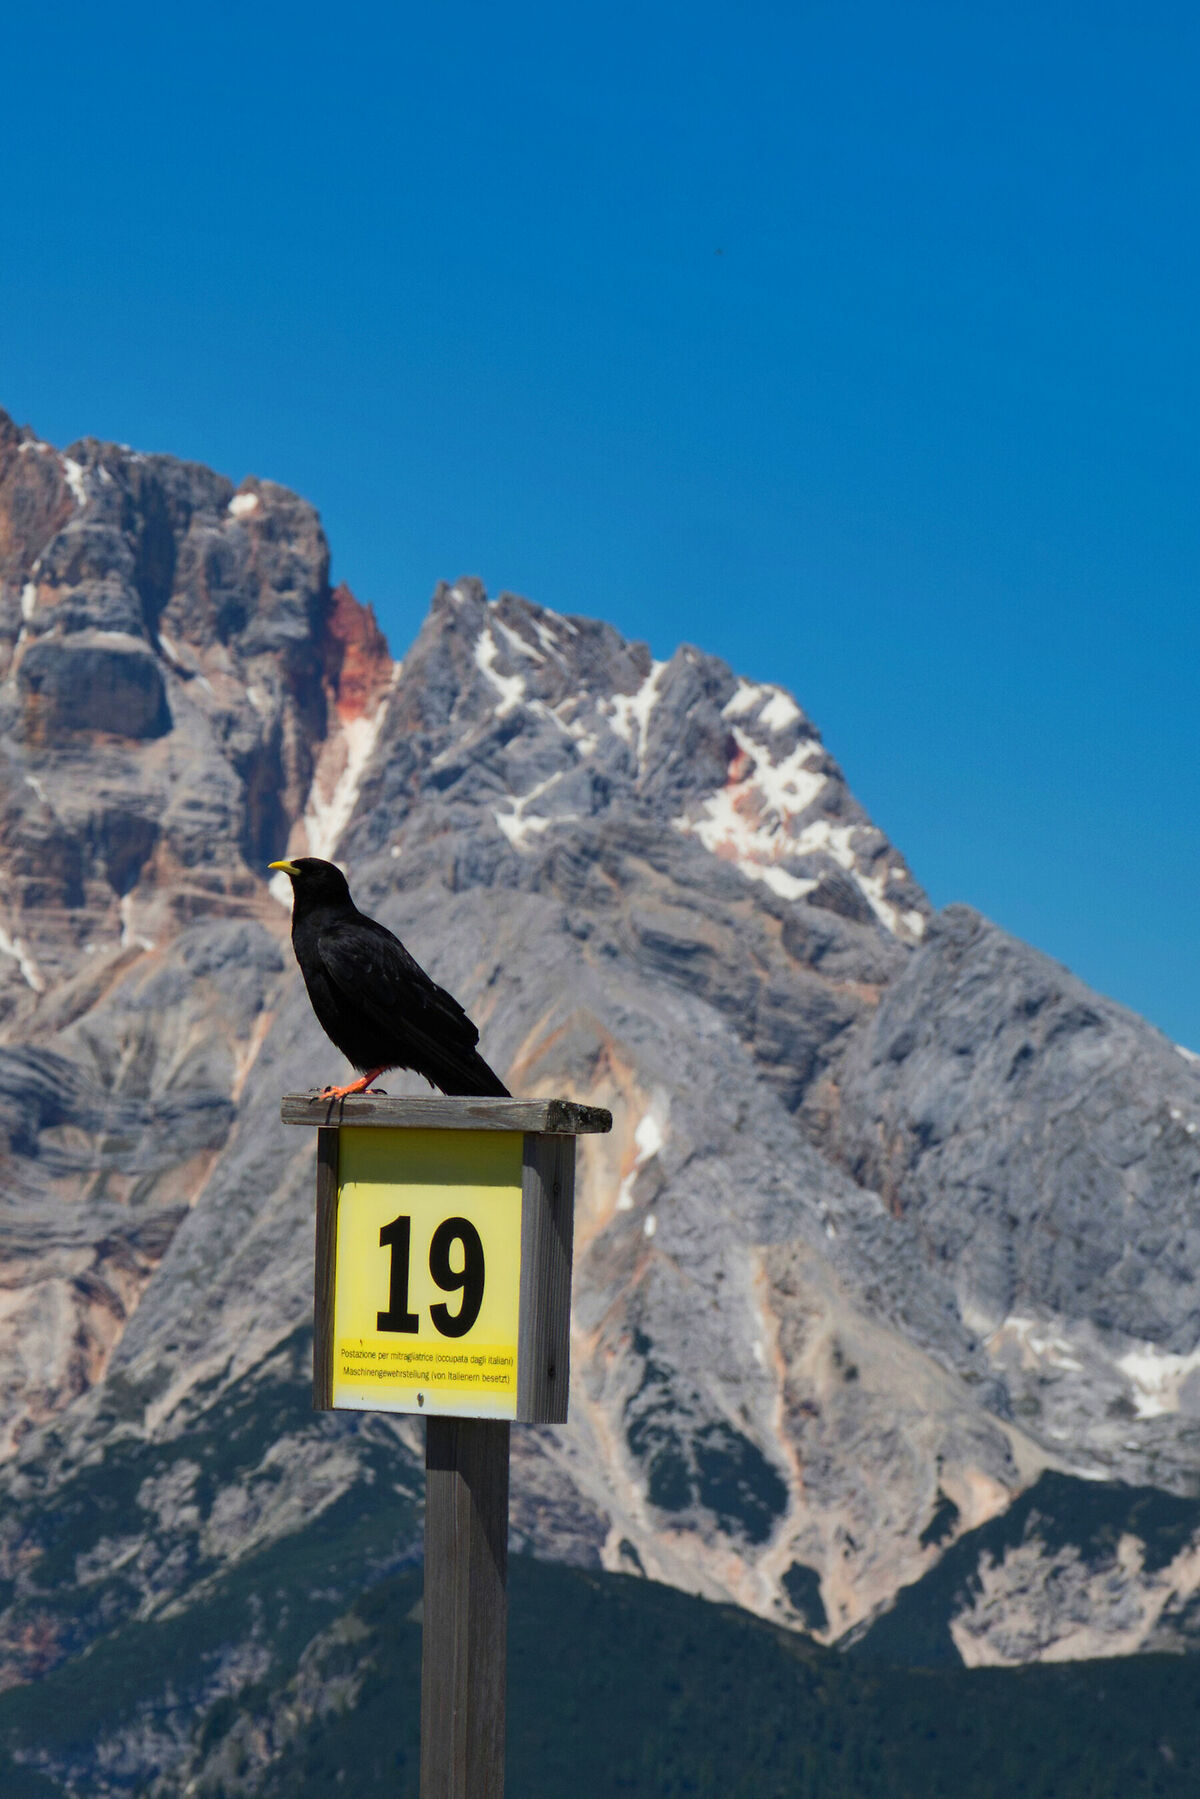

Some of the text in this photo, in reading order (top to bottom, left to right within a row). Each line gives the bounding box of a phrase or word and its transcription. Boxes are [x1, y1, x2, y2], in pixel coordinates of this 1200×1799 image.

[376, 1215, 486, 1338] 19
[341, 1348, 514, 1367] Postazione per mitragliatrice (occupata dagli italiani)
[343, 1366, 510, 1384] Maschinengewehrstellung (von Italienern besetzt)
